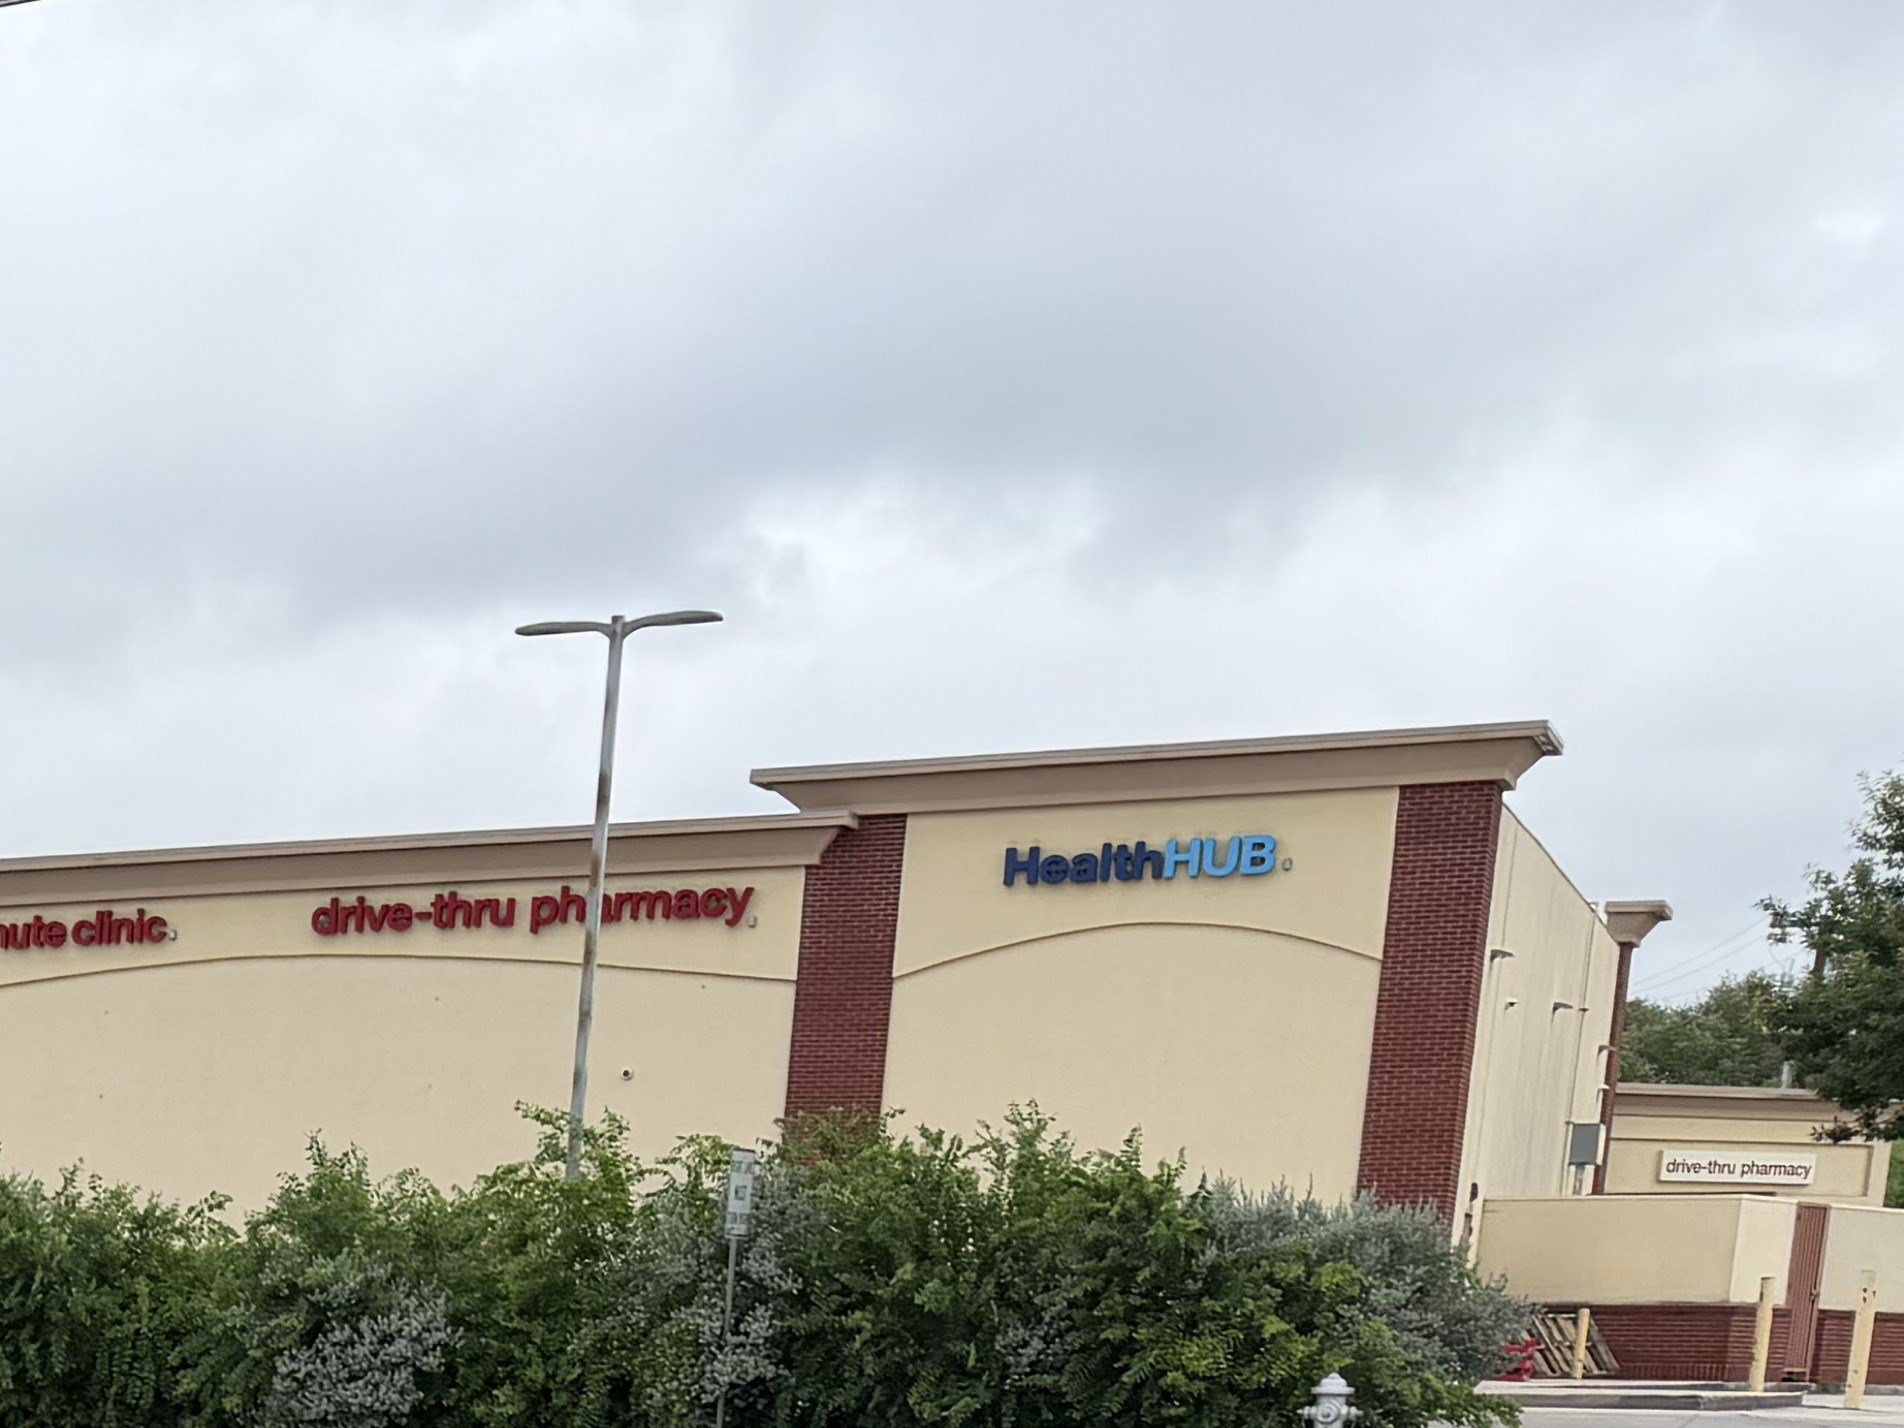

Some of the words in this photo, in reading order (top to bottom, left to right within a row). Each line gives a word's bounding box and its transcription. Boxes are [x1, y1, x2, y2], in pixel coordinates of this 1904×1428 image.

[1003, 835, 1276, 887] HealthHUB
[311, 896, 516, 935] drive-thru
[1665, 1158, 1737, 1175] drive-thru
[1741, 1160, 1812, 1180] pharmacy
